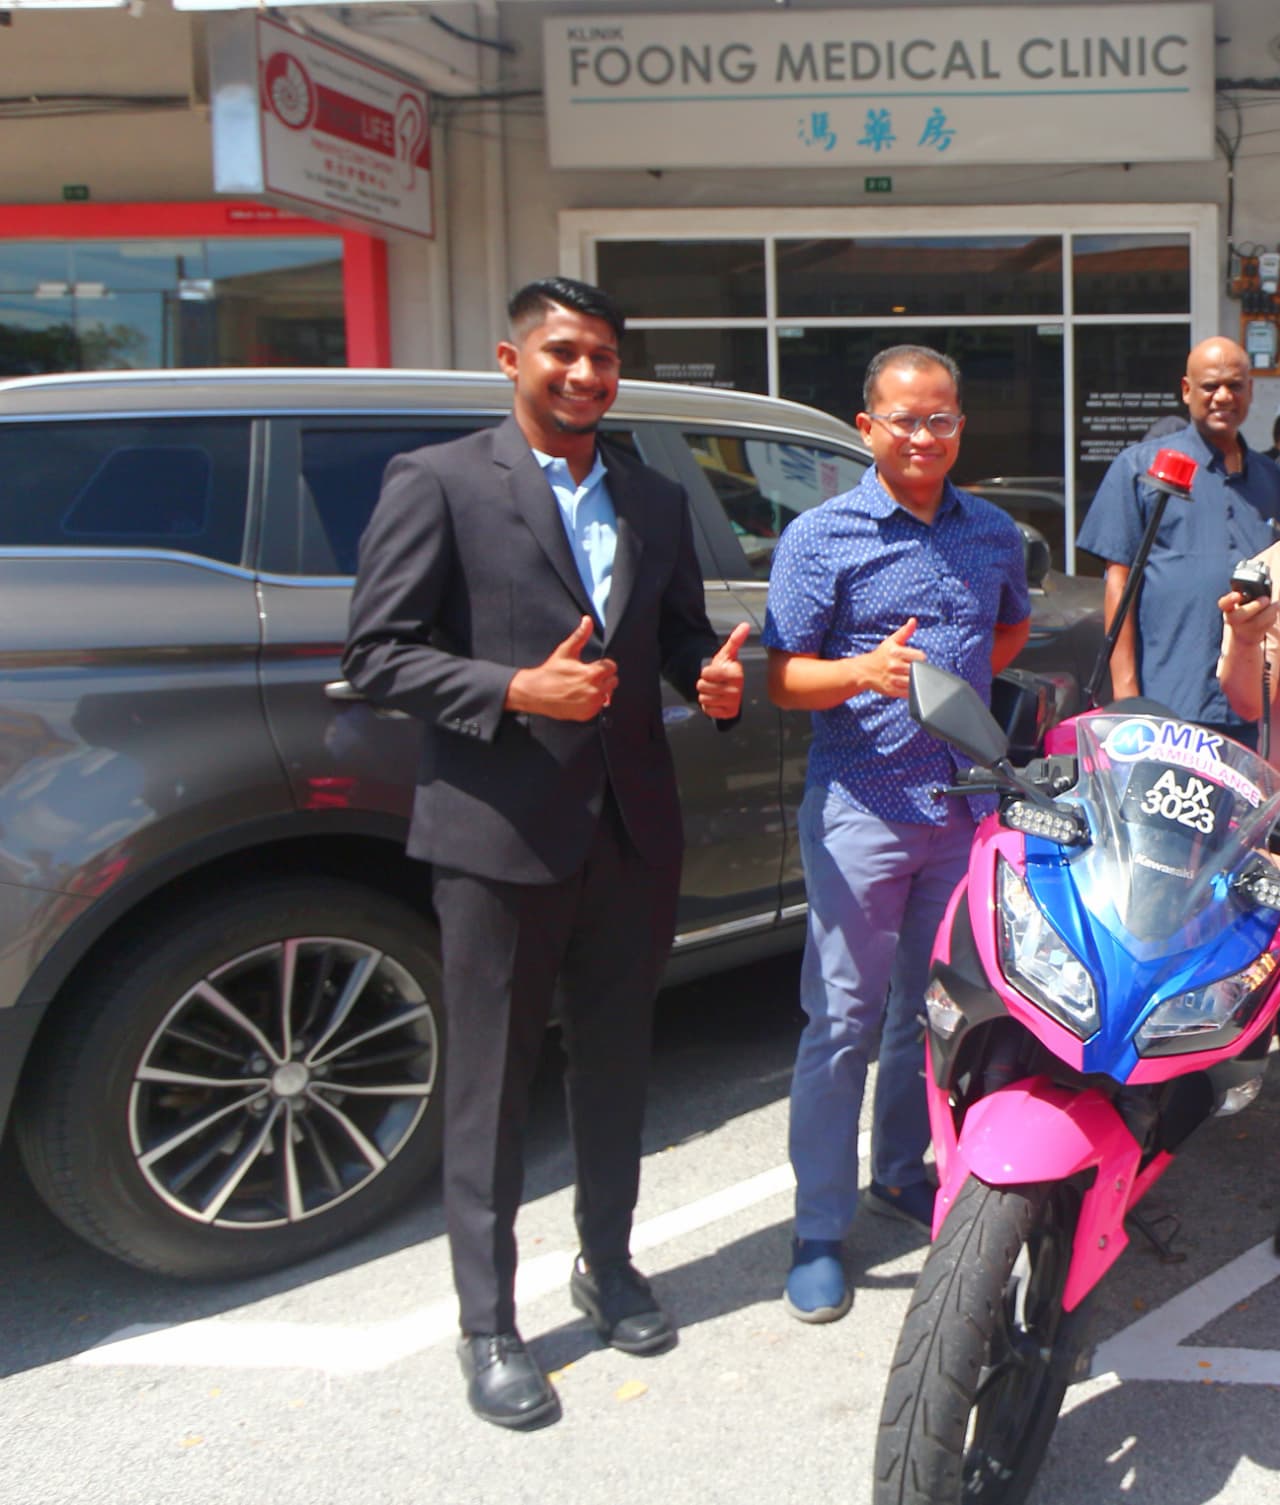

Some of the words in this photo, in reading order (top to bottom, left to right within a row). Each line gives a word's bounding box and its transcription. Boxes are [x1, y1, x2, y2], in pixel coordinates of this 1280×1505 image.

[568, 27, 623, 41] KLINIK
[570, 44, 757, 87] FOONG
[776, 39, 1001, 84] MEDICAL
[1018, 34, 1190, 80] CLINIC
[1161, 724, 1221, 760] MK
[1153, 747, 1261, 806] AMBULANCE
[1153, 769, 1214, 808] AJX
[1140, 789, 1216, 834] 3023
[1134, 852, 1195, 880] Kawasaki
